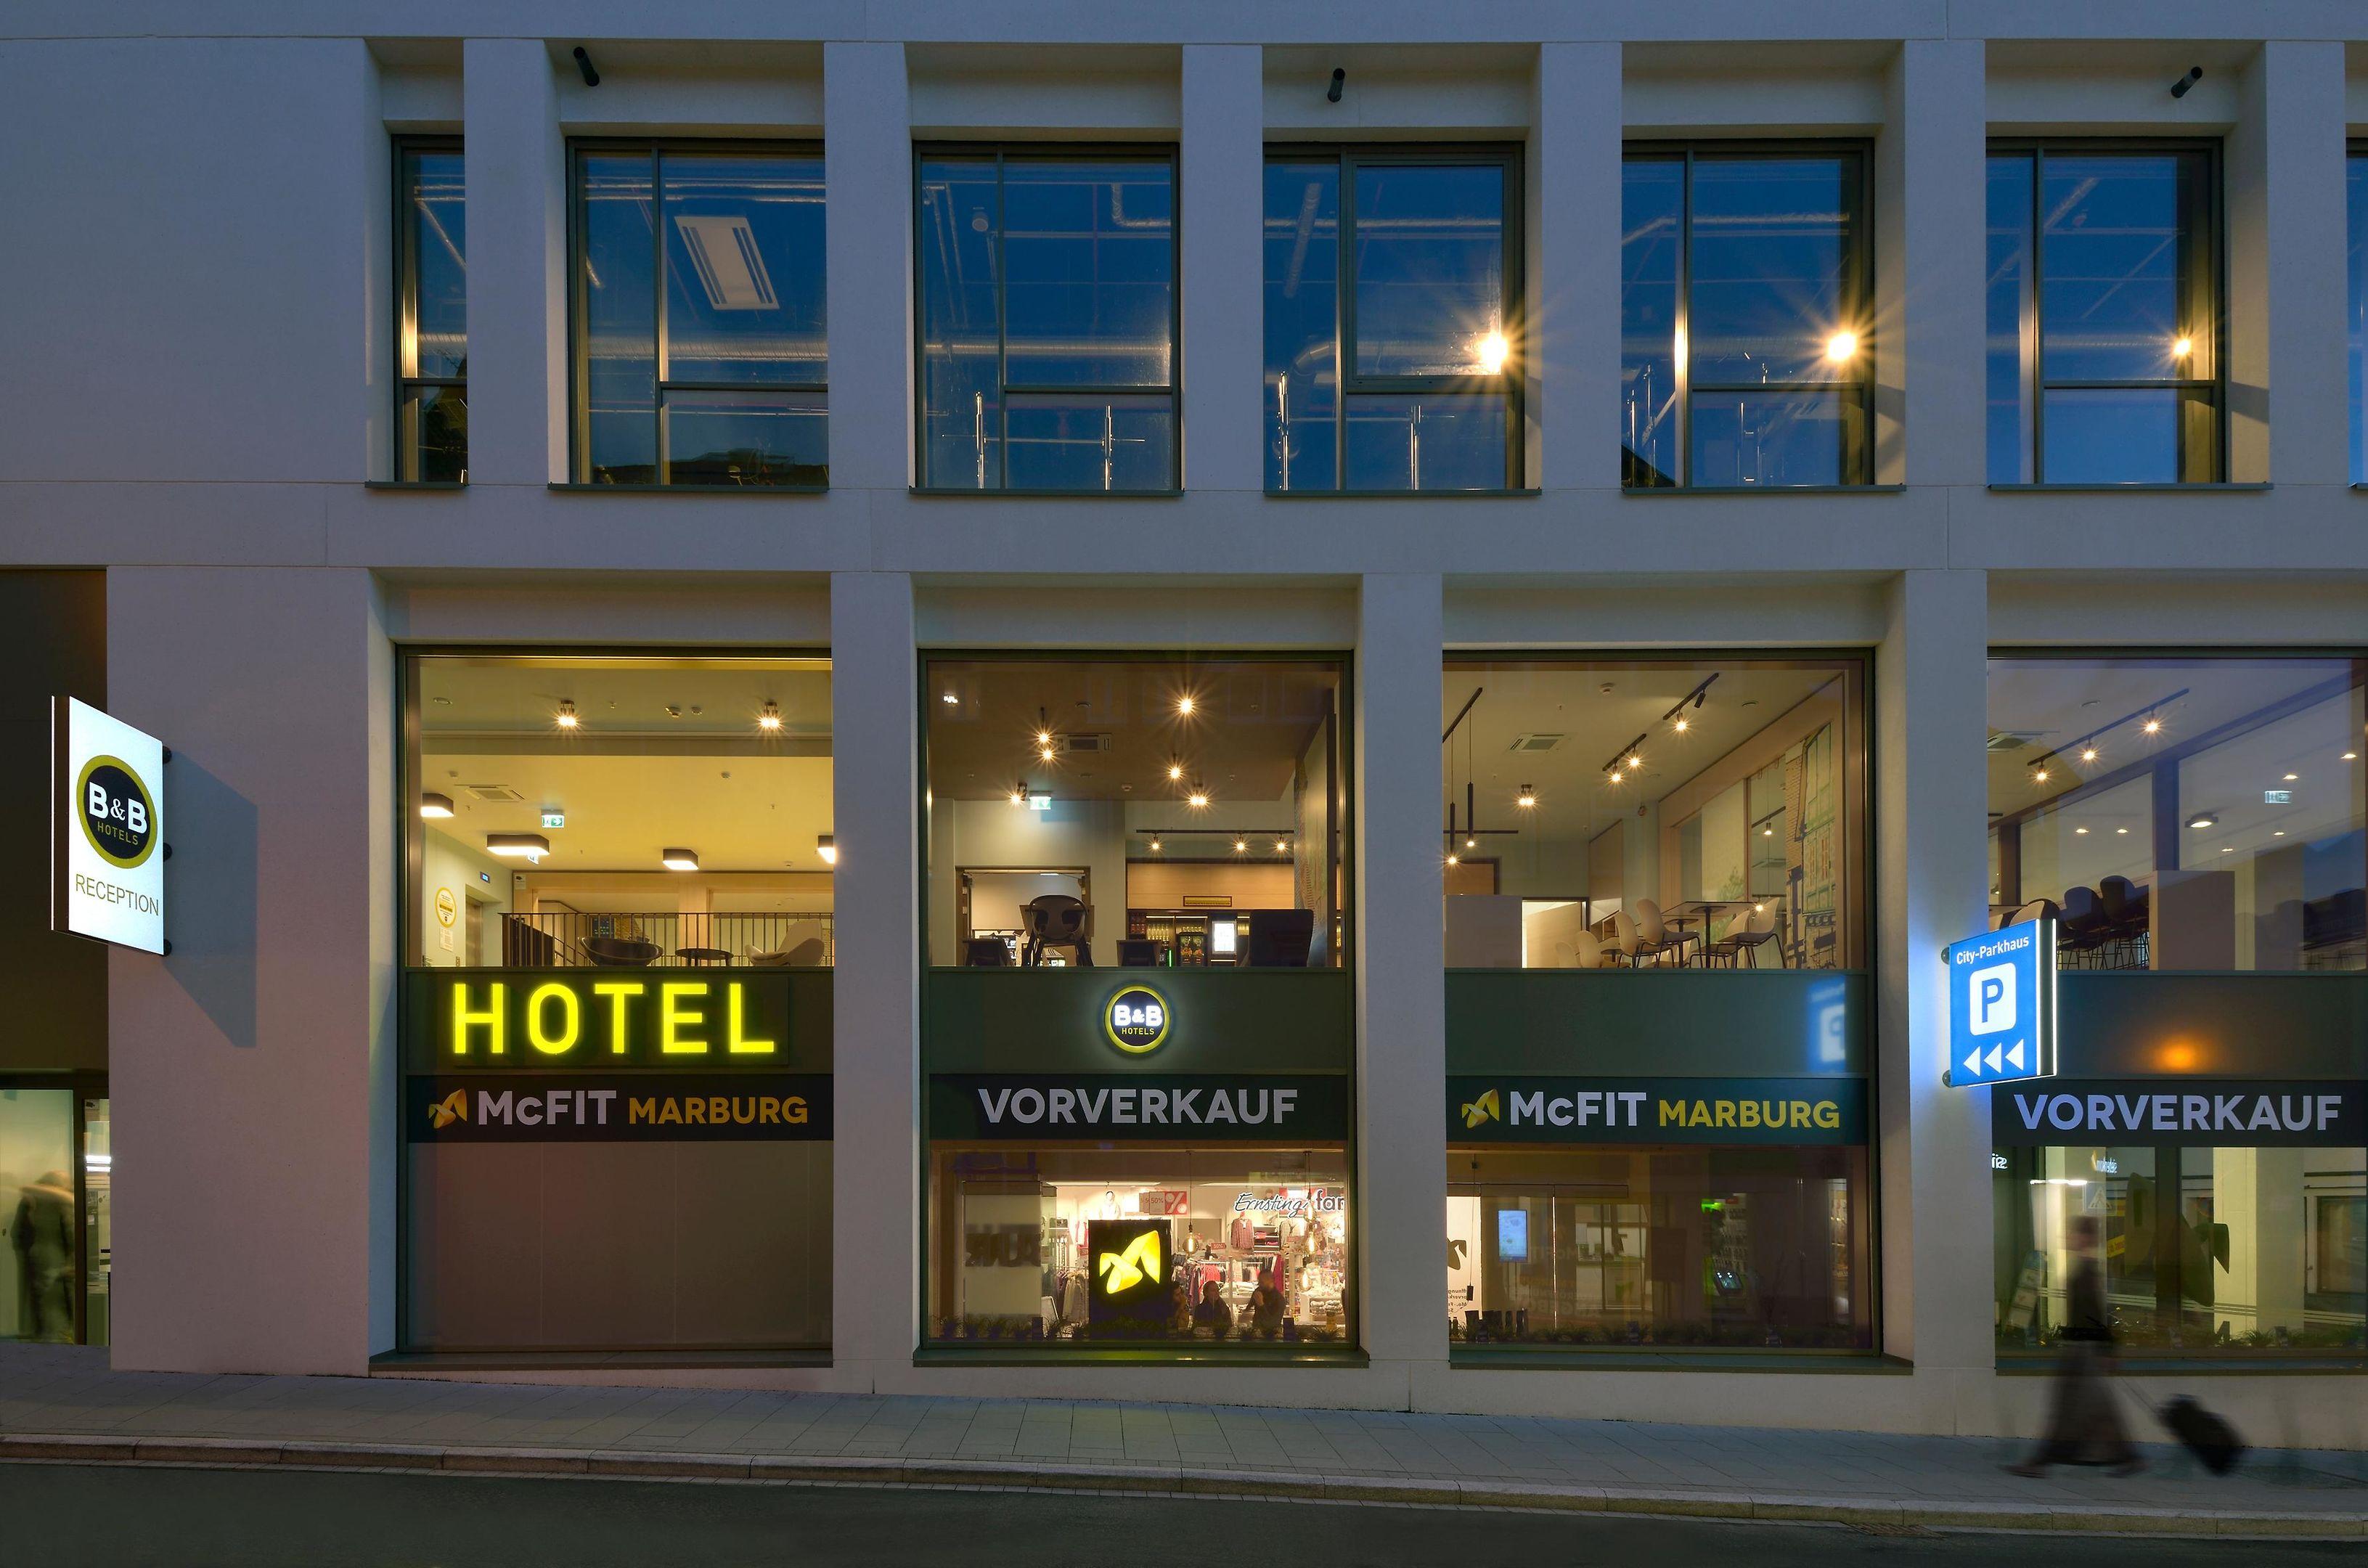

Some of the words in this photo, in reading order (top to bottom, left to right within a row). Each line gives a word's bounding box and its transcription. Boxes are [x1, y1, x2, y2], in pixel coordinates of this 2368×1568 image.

[89, 781, 148, 834] B&B
[97, 821, 139, 846] HOTELS
[75, 873, 159, 916] RECEPTION
[1956, 936, 2029, 965] City-Parkhaus
[453, 982, 775, 1054] HOTEL
[1114, 1005, 1163, 1026] B&B
[1981, 977, 2004, 1023] P
[478, 1090, 617, 1125] McFIT
[629, 1097, 808, 1124] MARBURG
[978, 1088, 1298, 1124] VORVERKAUF
[1510, 1091, 1646, 1127] McFIT
[1659, 1100, 1840, 1128] MARBURG
[2014, 1094, 2342, 1131] VORVERKAUF
[1235, 1193, 1309, 1219] Ernsting
